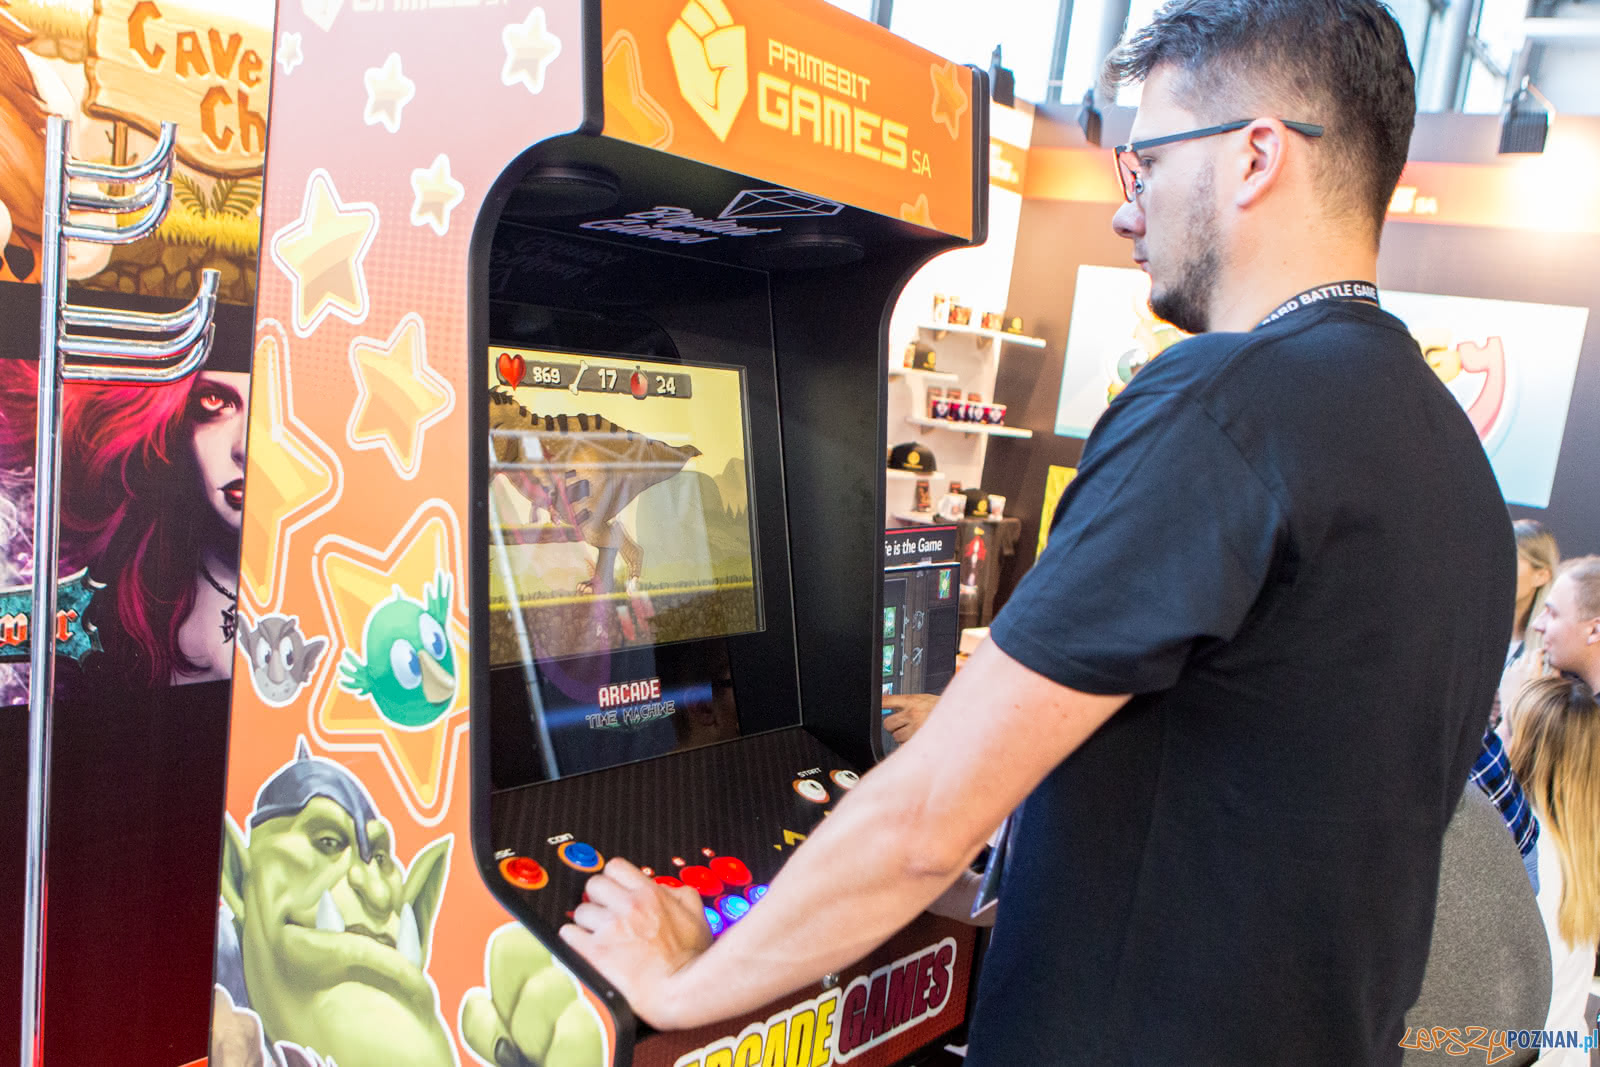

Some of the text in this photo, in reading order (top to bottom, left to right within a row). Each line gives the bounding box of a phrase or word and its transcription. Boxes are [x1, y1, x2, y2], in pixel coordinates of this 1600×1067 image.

[768, 38, 870, 102] PRIMEBIT
[758, 71, 909, 169] GAMES
[911, 149, 932, 178] SA
[1299, 284, 1352, 305] BATTLE
[532, 366, 676, 395] 869 17 24
[893, 540, 901, 556] is
[902, 538, 917, 554] the
[918, 537, 943, 553] Game
[598, 679, 661, 708] ARCADE
[836, 942, 956, 1056] GAMES
